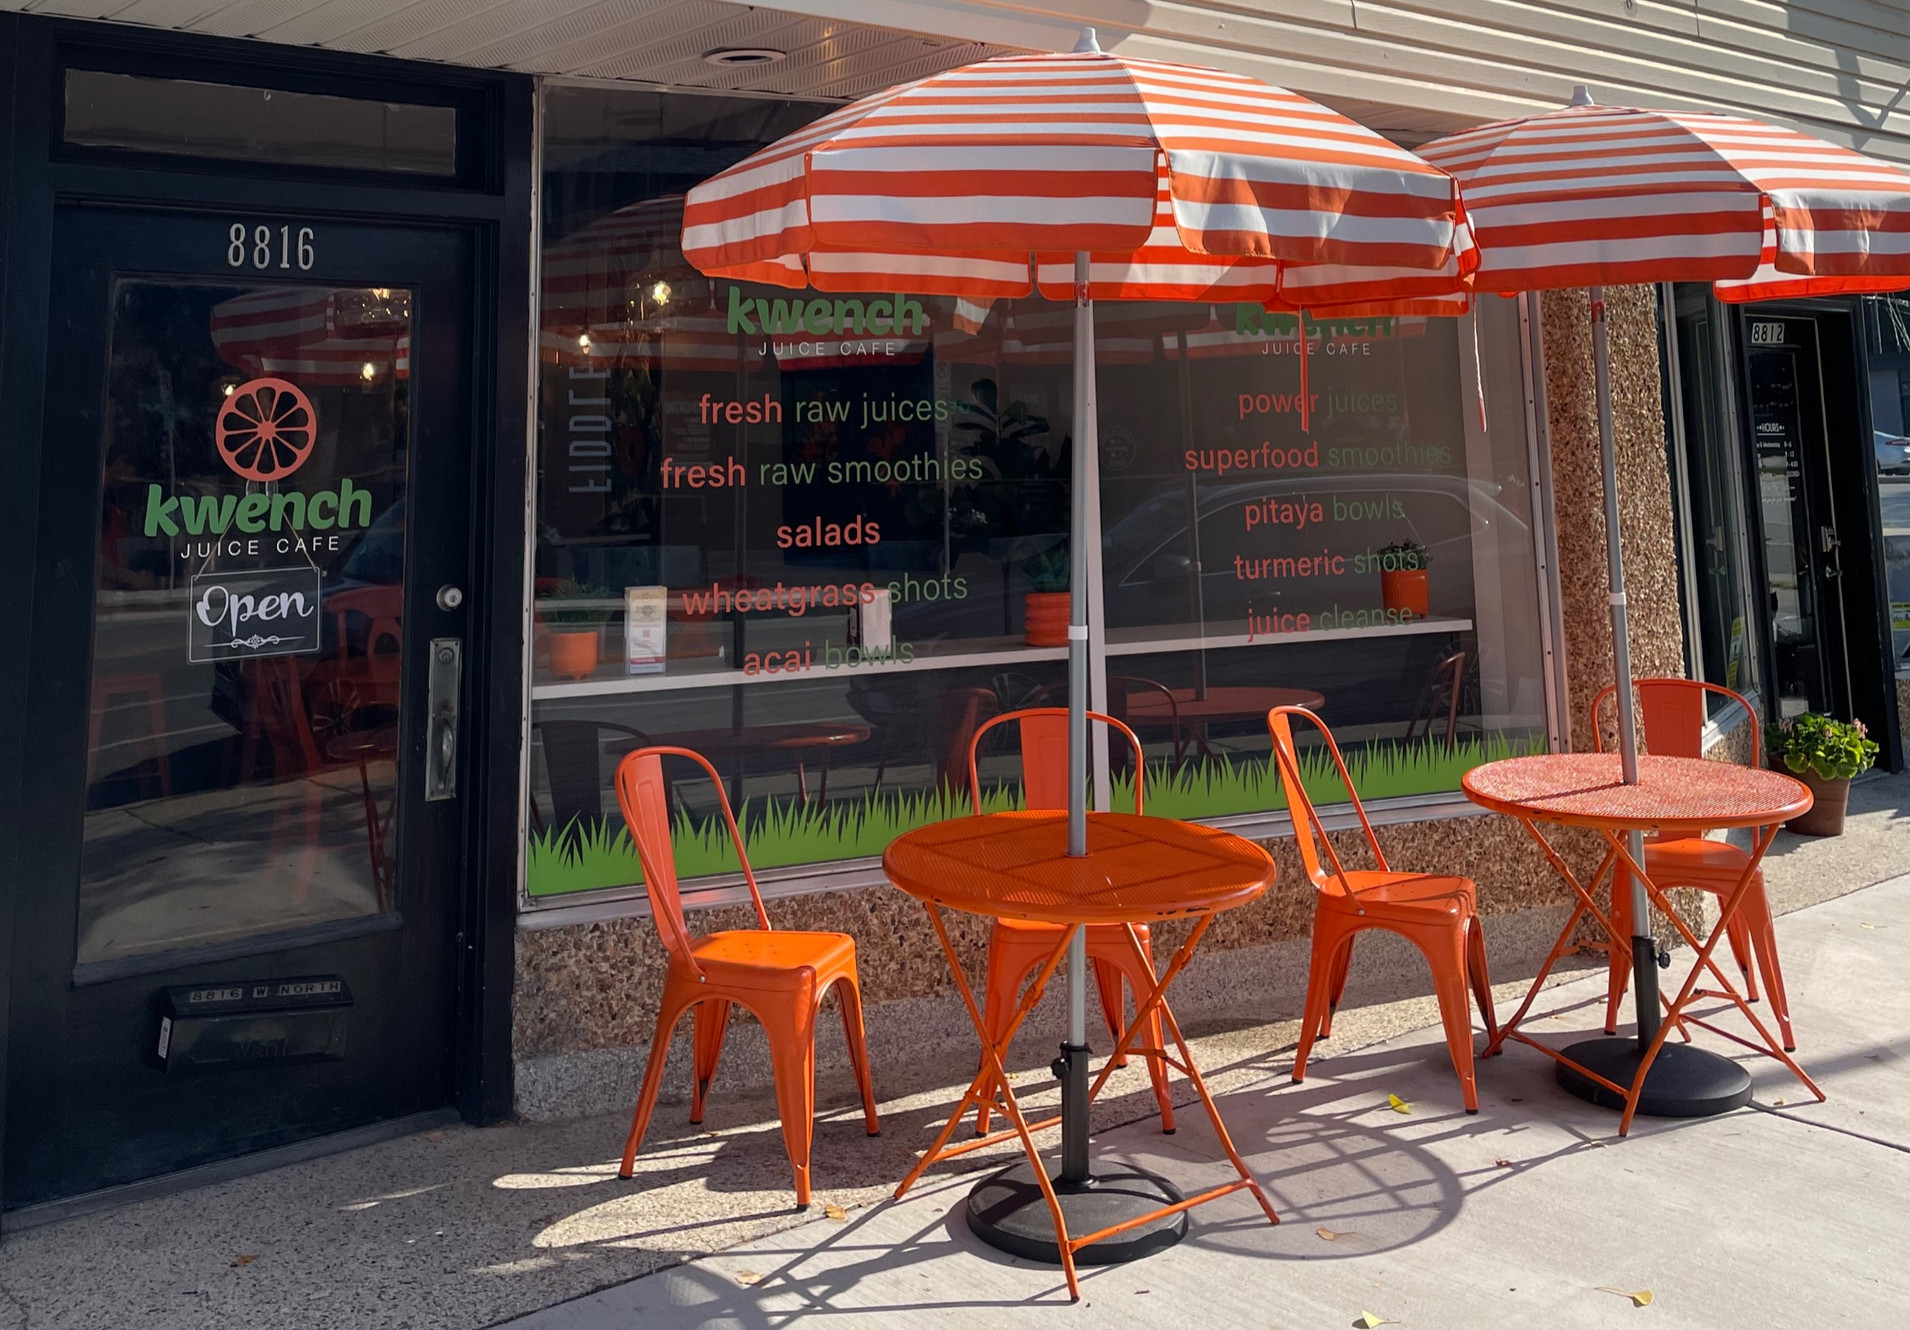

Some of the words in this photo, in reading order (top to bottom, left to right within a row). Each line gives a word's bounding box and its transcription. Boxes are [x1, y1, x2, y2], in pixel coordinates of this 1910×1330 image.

[228, 223, 314, 270] 8816
[727, 286, 923, 336] kwench
[758, 342, 825, 356] JUICE
[840, 342, 895, 356] CAFE
[1262, 342, 1315, 356] JUICE
[1326, 342, 1371, 356] CAFE
[1753, 324, 1783, 342] 8812
[699, 394, 783, 424] fresh
[795, 401, 851, 423] raw
[860, 392, 949, 429] juices
[1328, 386, 1397, 419] juices
[661, 457, 746, 488] fresh
[759, 463, 816, 486] raw
[828, 451, 983, 484] smoothies
[1185, 442, 1319, 476] superfood
[1327, 438, 1452, 468] smoothies
[144, 478, 372, 537] kwench
[1244, 496, 1324, 530] pitaya
[1333, 493, 1405, 523] bowls
[181, 539, 260, 559] JUICE
[276, 536, 340, 554] CAFE
[776, 515, 881, 549] salads
[1234, 549, 1345, 581] turmeric
[1353, 546, 1420, 575] shots
[196, 585, 314, 637] Open
[683, 582, 876, 617] wheatgrass
[888, 572, 969, 604] shots
[1247, 606, 1311, 643] juice
[1319, 602, 1413, 632] cleanse
[743, 641, 811, 676] acai
[825, 634, 915, 669] bowls
[192, 989, 240, 1001] 8816
[256, 987, 267, 996] W
[280, 982, 340, 994] NORTH
